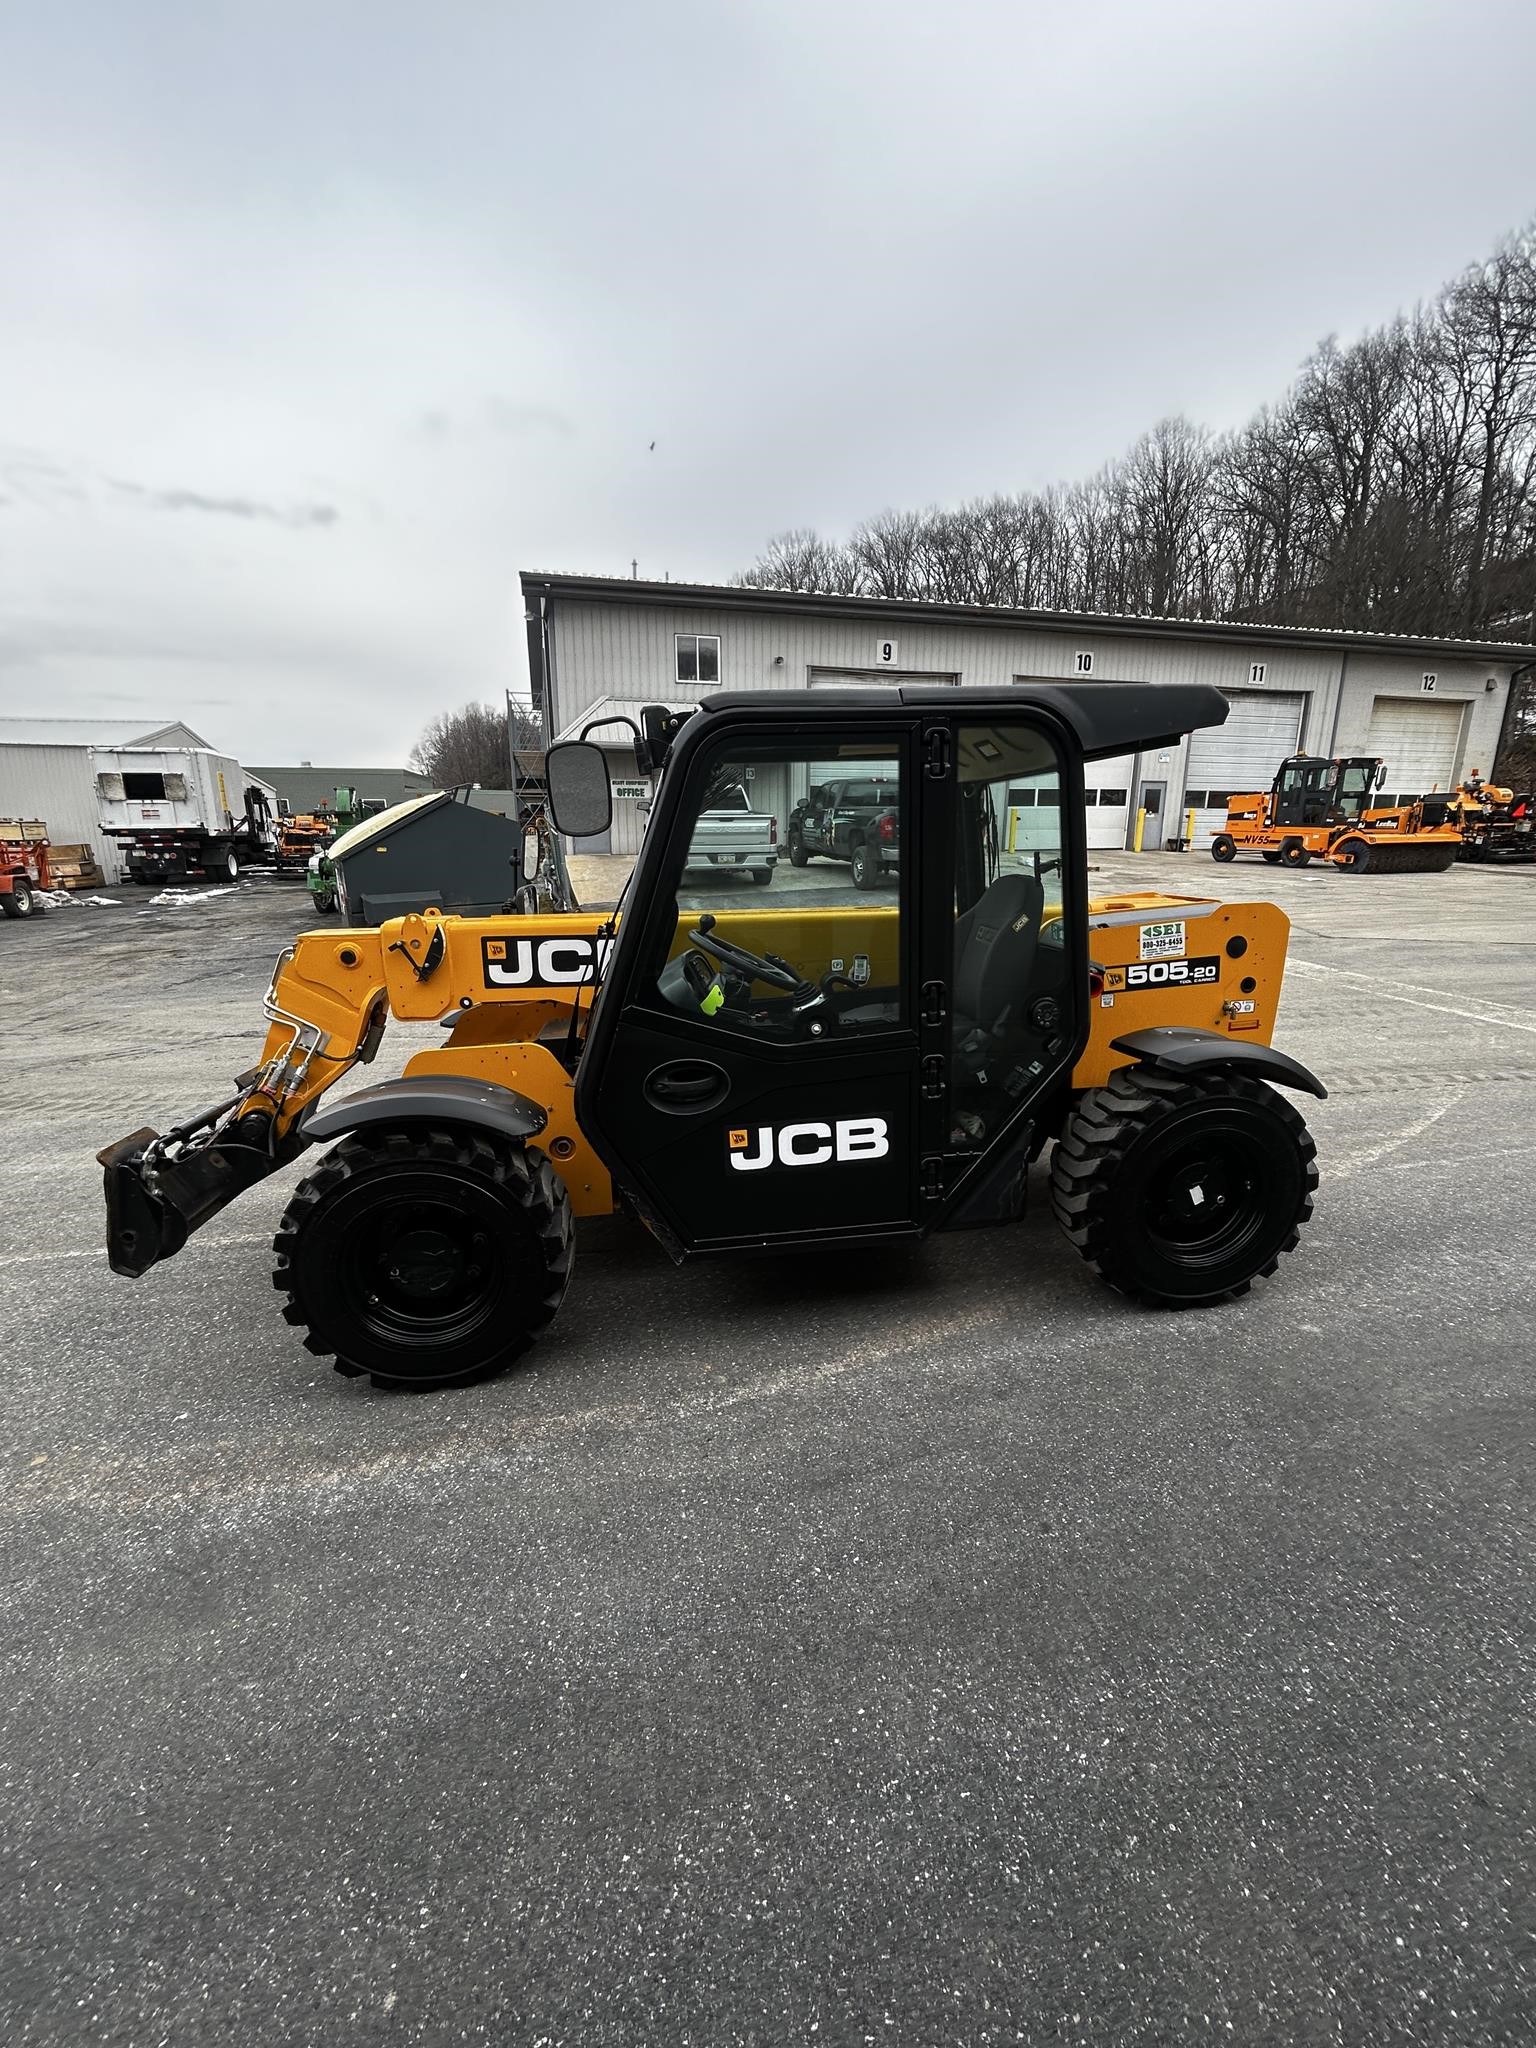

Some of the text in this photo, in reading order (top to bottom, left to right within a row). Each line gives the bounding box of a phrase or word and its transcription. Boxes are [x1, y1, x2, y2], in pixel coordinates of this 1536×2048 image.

[883, 643, 892, 662] 9
[1077, 653, 1092, 672] 10
[1252, 665, 1265, 682] 11
[1423, 675, 1436, 691] 12
[616, 787, 646, 797] OFFICE
[1243, 835, 1271, 844] NV55
[1152, 923, 1182, 937] SEI
[1142, 937, 1183, 950] 800-325-6455
[1127, 960, 1217, 985] 505-20
[730, 1117, 890, 1171] JCB
